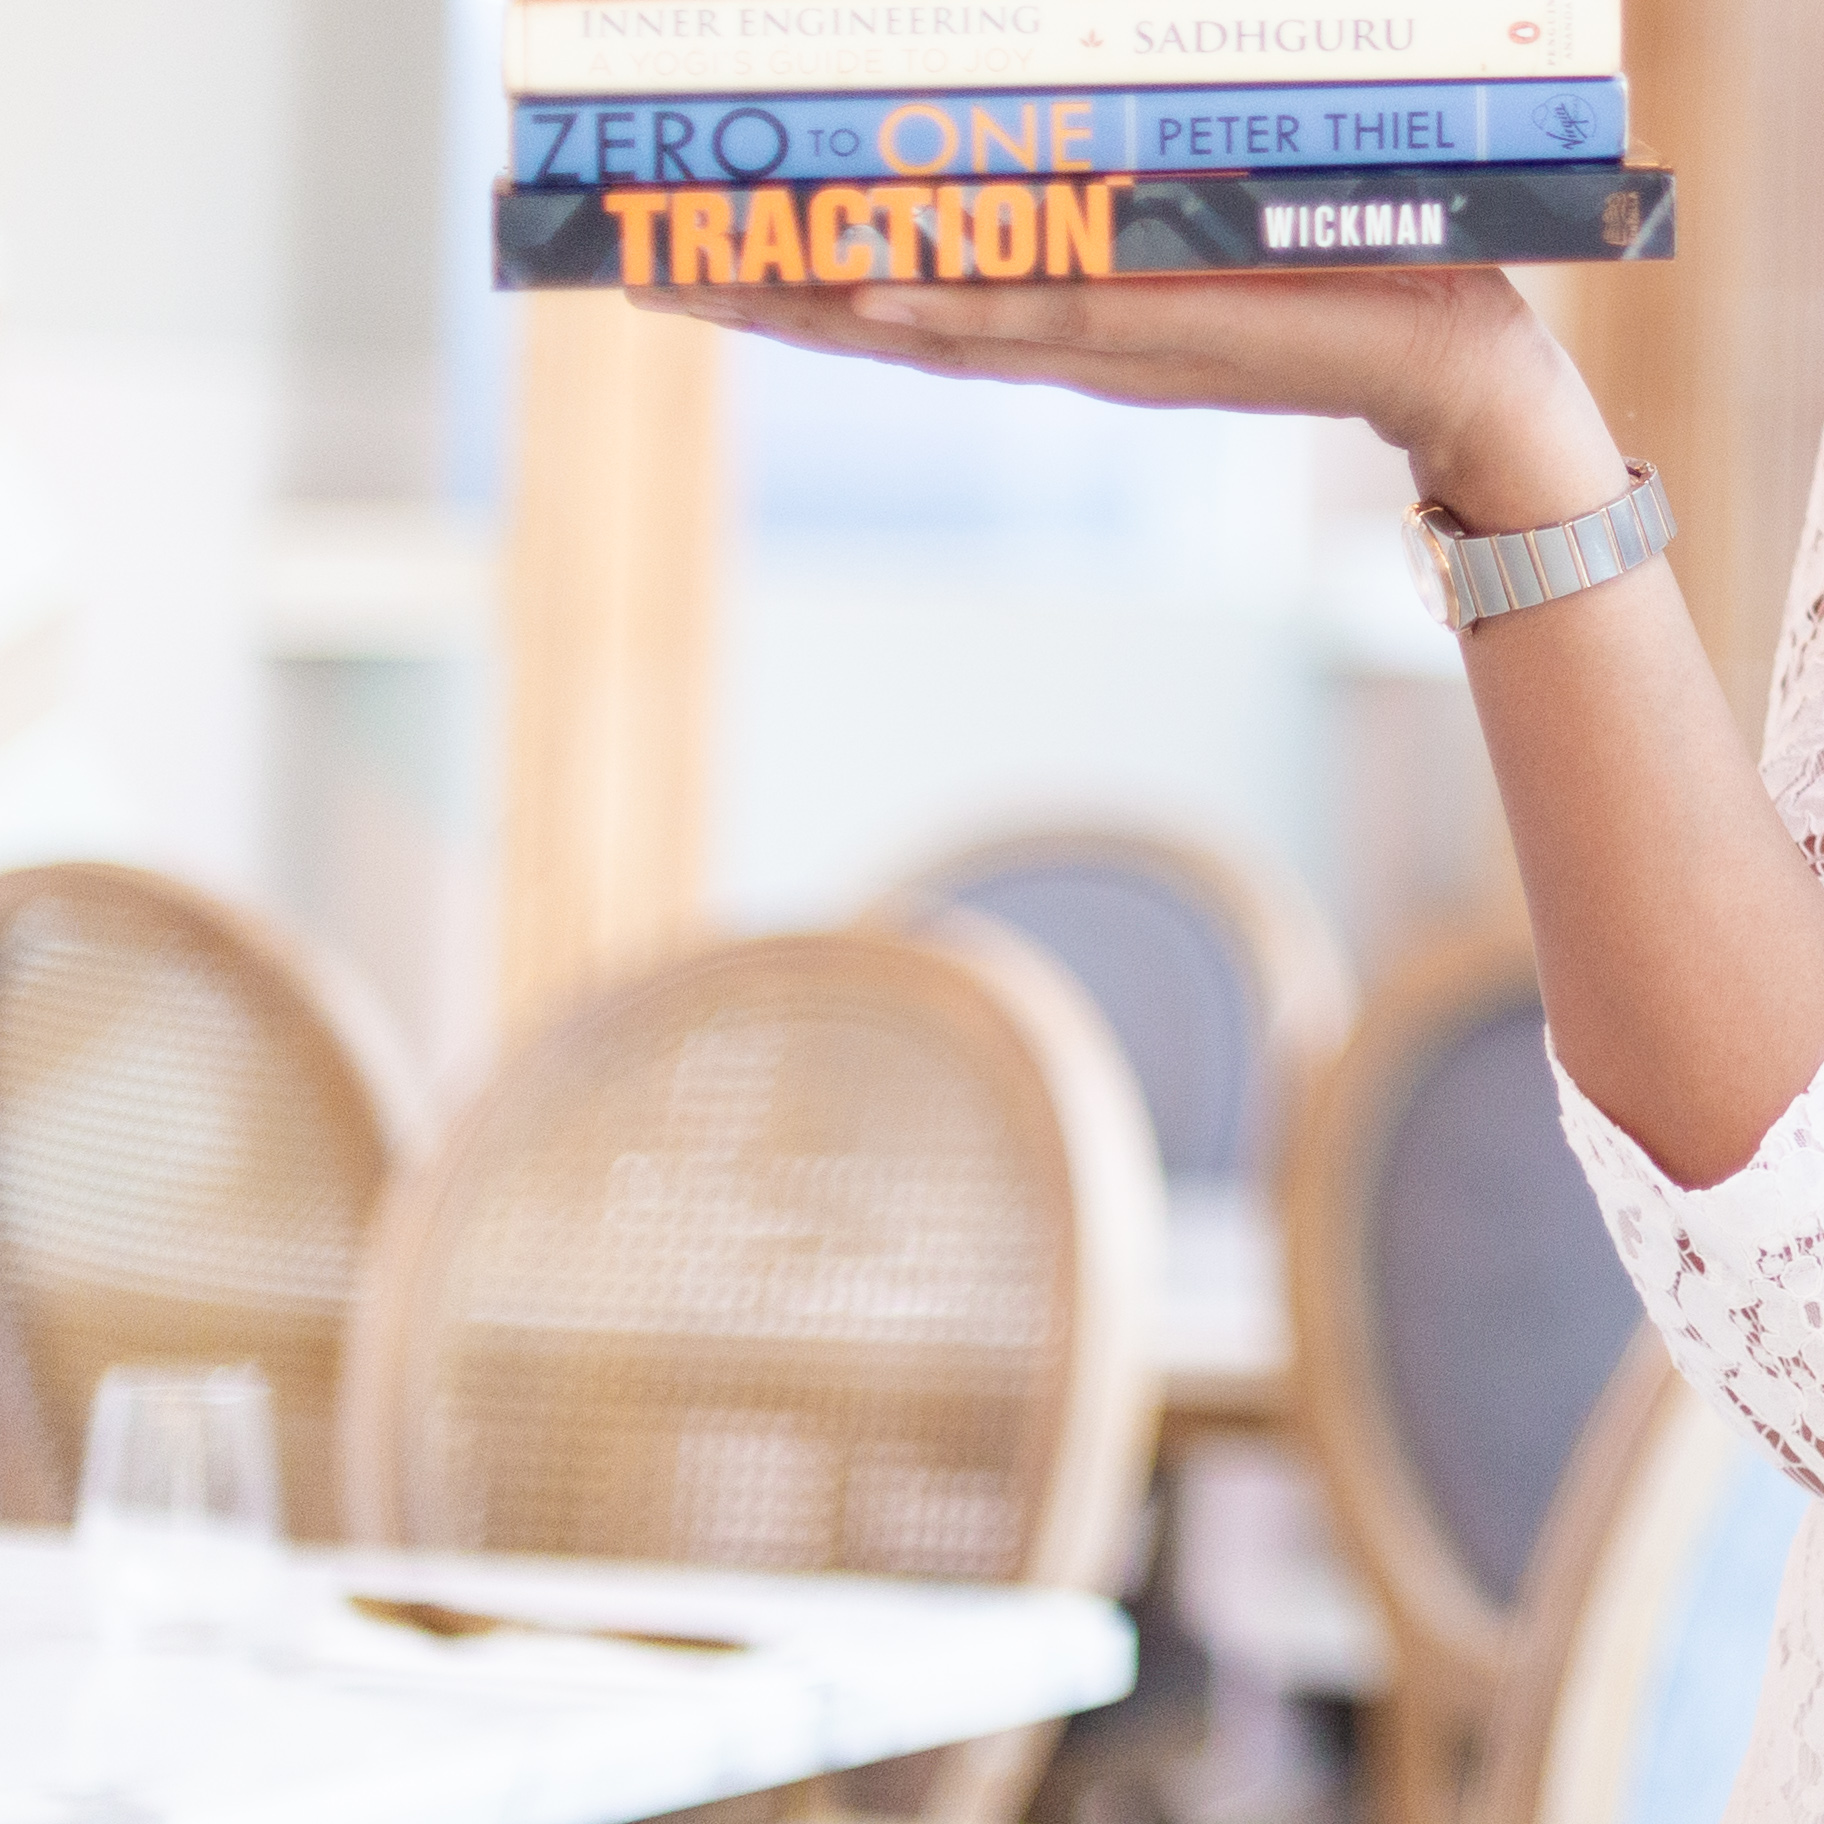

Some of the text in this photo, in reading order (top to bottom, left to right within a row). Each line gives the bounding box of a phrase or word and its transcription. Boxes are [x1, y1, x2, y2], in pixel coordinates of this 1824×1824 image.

[581, 5, 1042, 38] INNER ENGINEERING
[1133, 18, 1416, 55] SADHGURU
[1563, 0, 1573, 61] ANANDA
[587, 52, 612, 77] A
[768, 49, 885, 76] GUIDE
[902, 48, 950, 74] TO
[962, 47, 1036, 74] JOY
[531, 99, 1092, 183] ZERO TO ONE
[1158, 110, 1455, 156] PETER THIEL
[1546, 103, 1589, 151] Virgin
[604, 182, 1114, 286] TRACTION
[1264, 203, 1443, 249] WICKMAN
